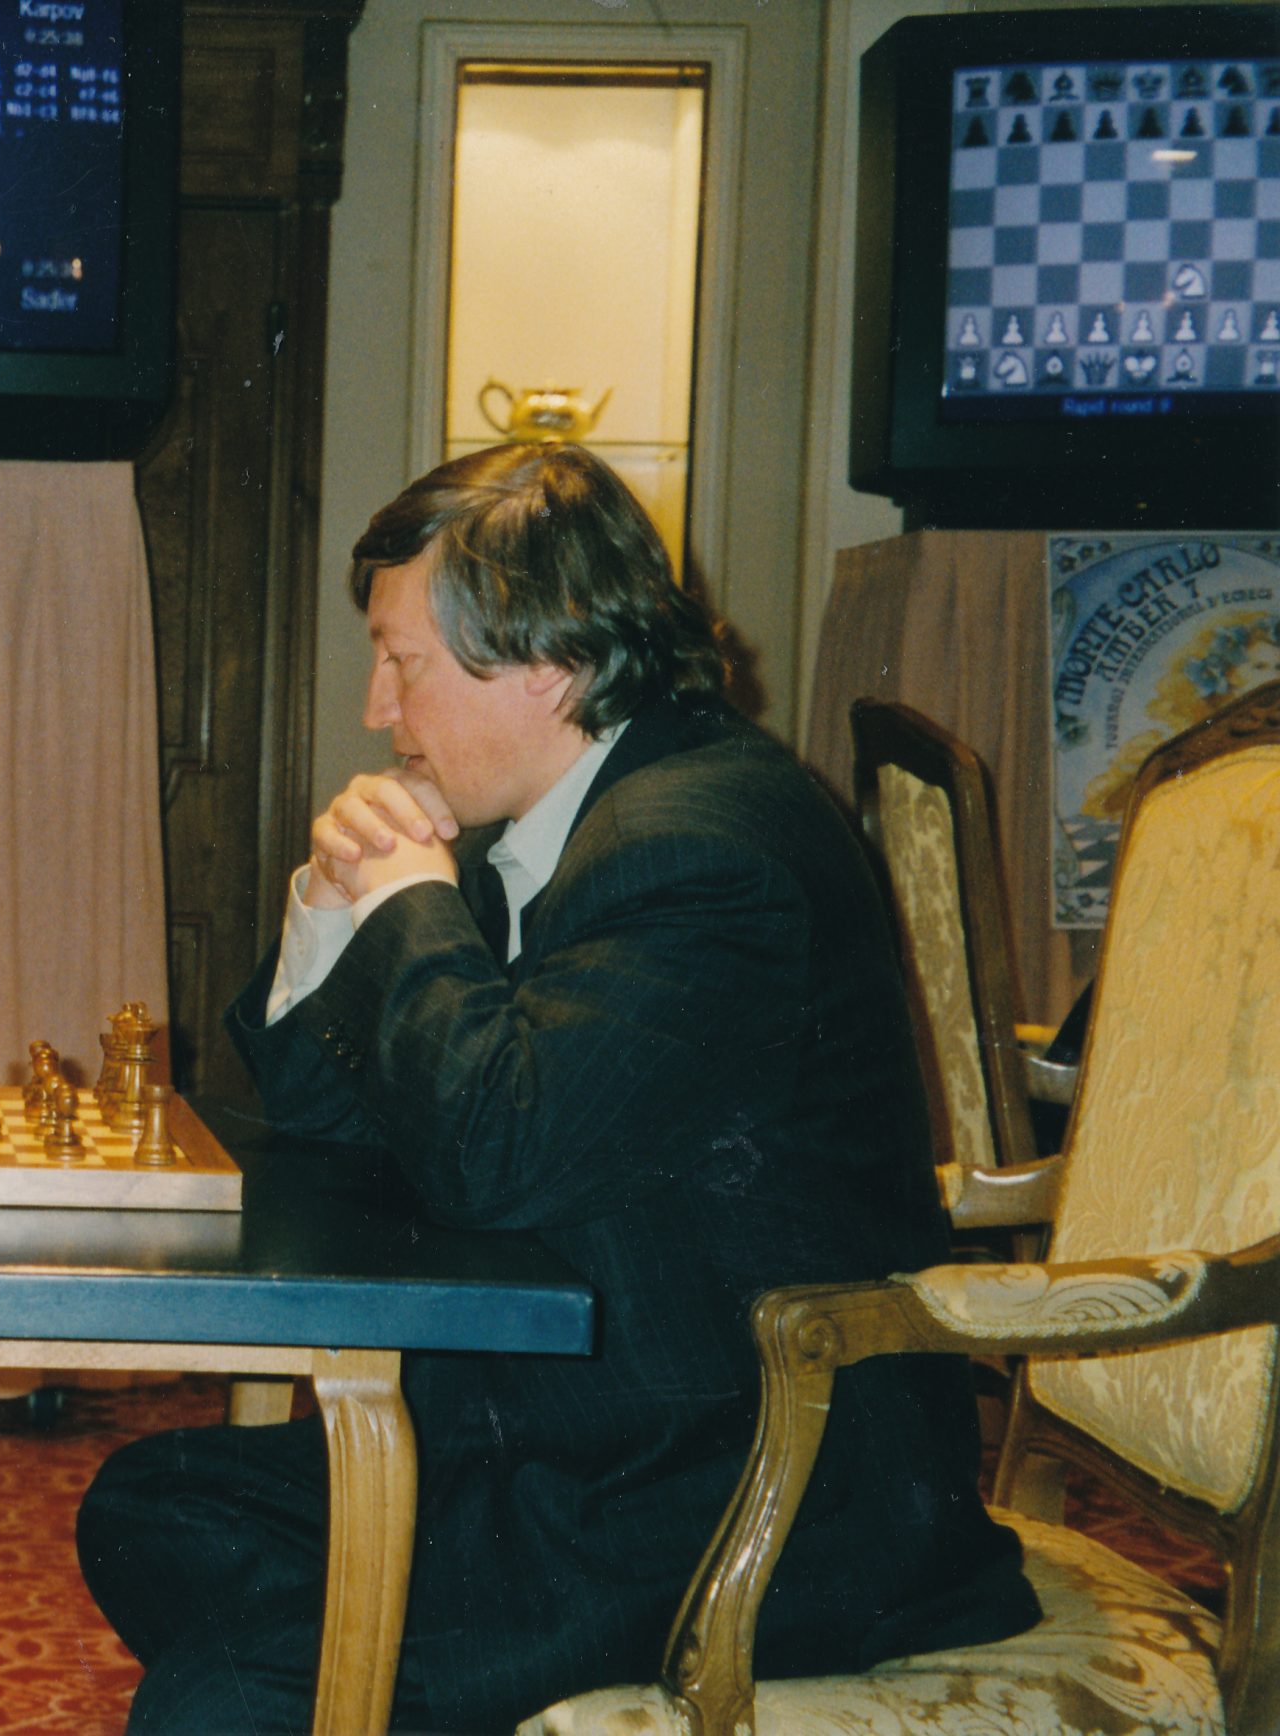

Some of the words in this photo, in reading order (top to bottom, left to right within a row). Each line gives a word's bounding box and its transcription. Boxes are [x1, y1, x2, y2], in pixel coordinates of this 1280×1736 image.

[19, 0, 86, 23] Karpov
[1092, 592, 1179, 683] AMBER
[1182, 577, 1199, 599] 7
